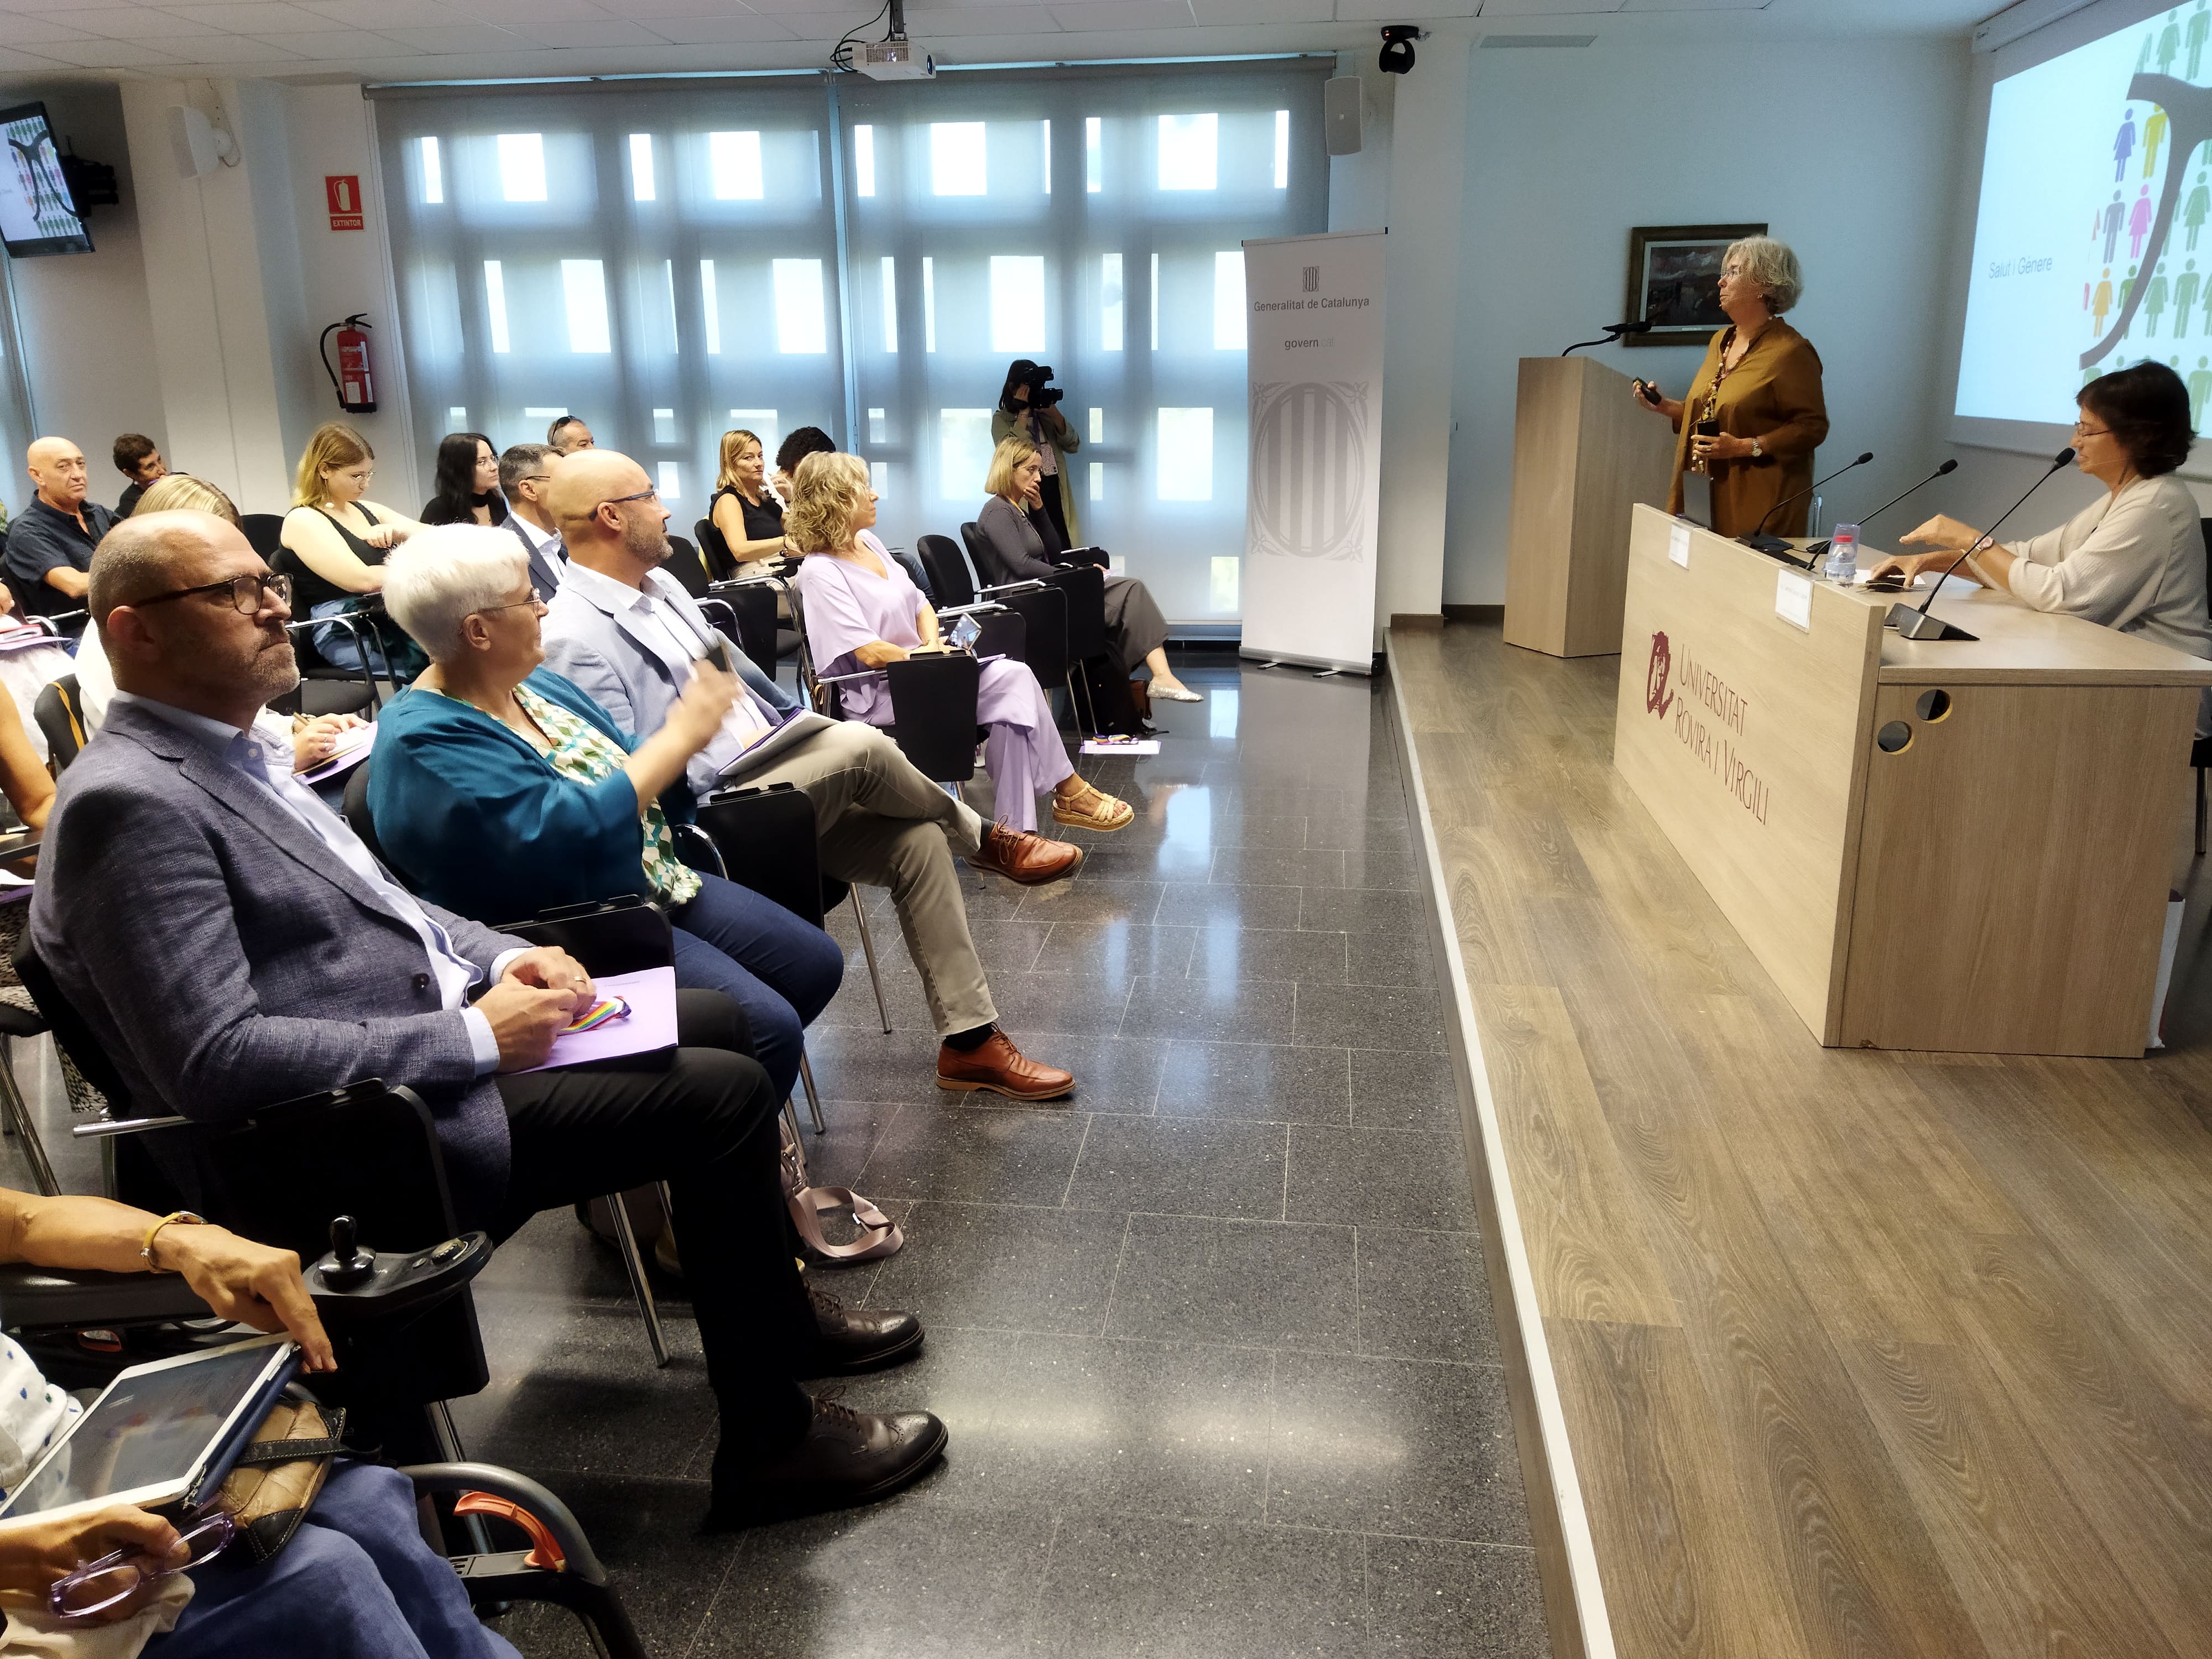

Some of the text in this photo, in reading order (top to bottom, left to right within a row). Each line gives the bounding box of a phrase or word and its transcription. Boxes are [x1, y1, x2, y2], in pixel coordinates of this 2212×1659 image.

[1989, 260, 2011, 279] Salut
[1254, 297, 1370, 311] Generalitat de Catalunya
[1681, 644, 1747, 736] UNIVERSITAT
[1675, 696, 1768, 825] ROVIRA I VIRGILI
